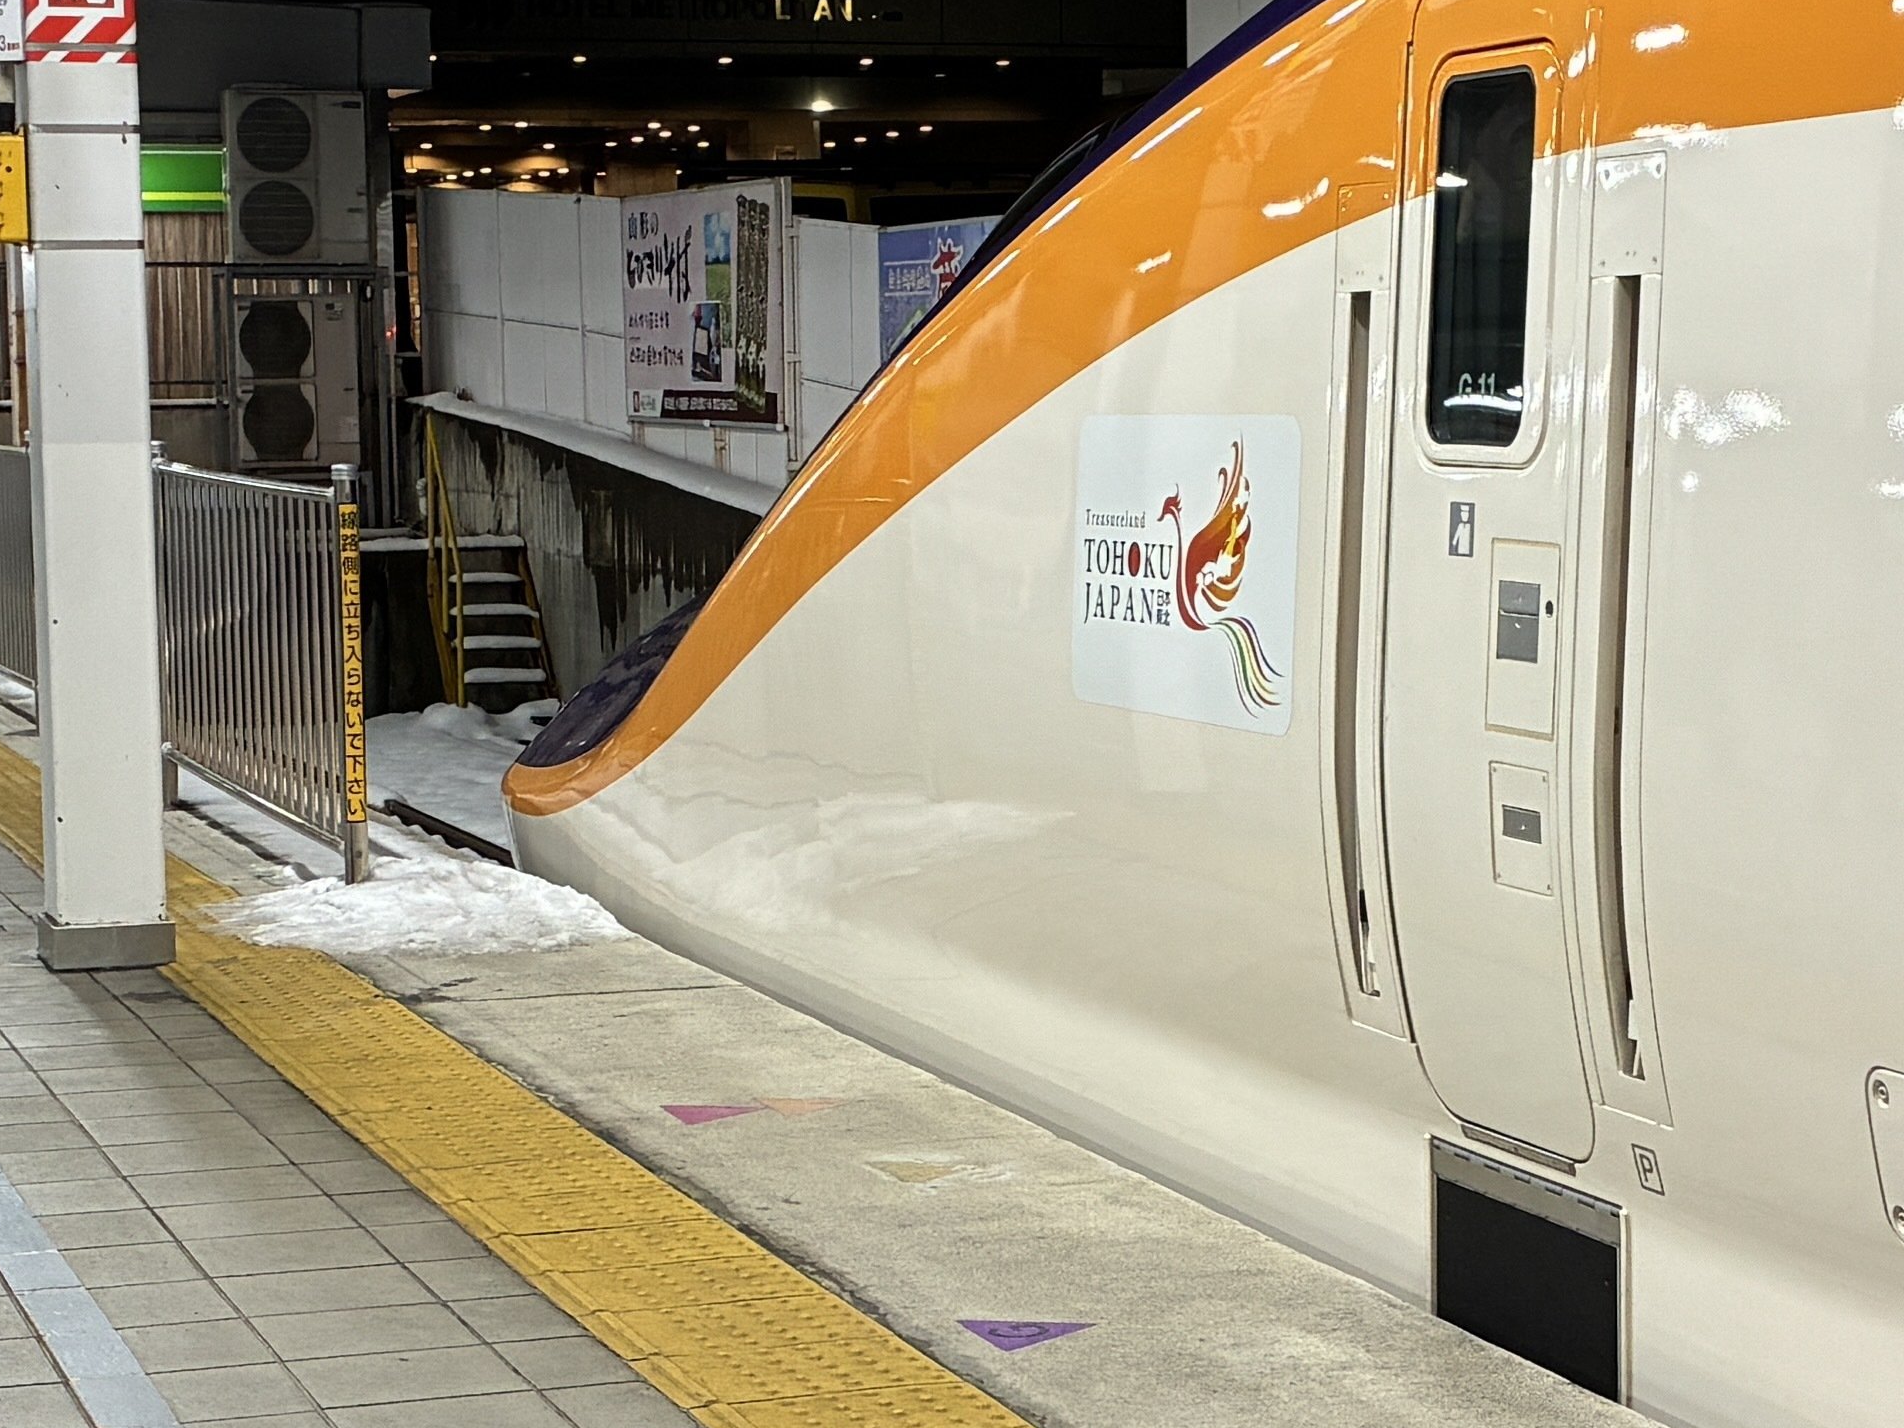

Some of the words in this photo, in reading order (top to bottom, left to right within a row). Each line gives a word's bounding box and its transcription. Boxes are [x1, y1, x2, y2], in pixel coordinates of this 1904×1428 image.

[1085, 509, 1146, 529] Treasureland
[1084, 539, 1173, 580] TOHOKU
[1083, 582, 1155, 624] JAPAN
[340, 510, 367, 818] 線路側に立ち入らないで下さい
